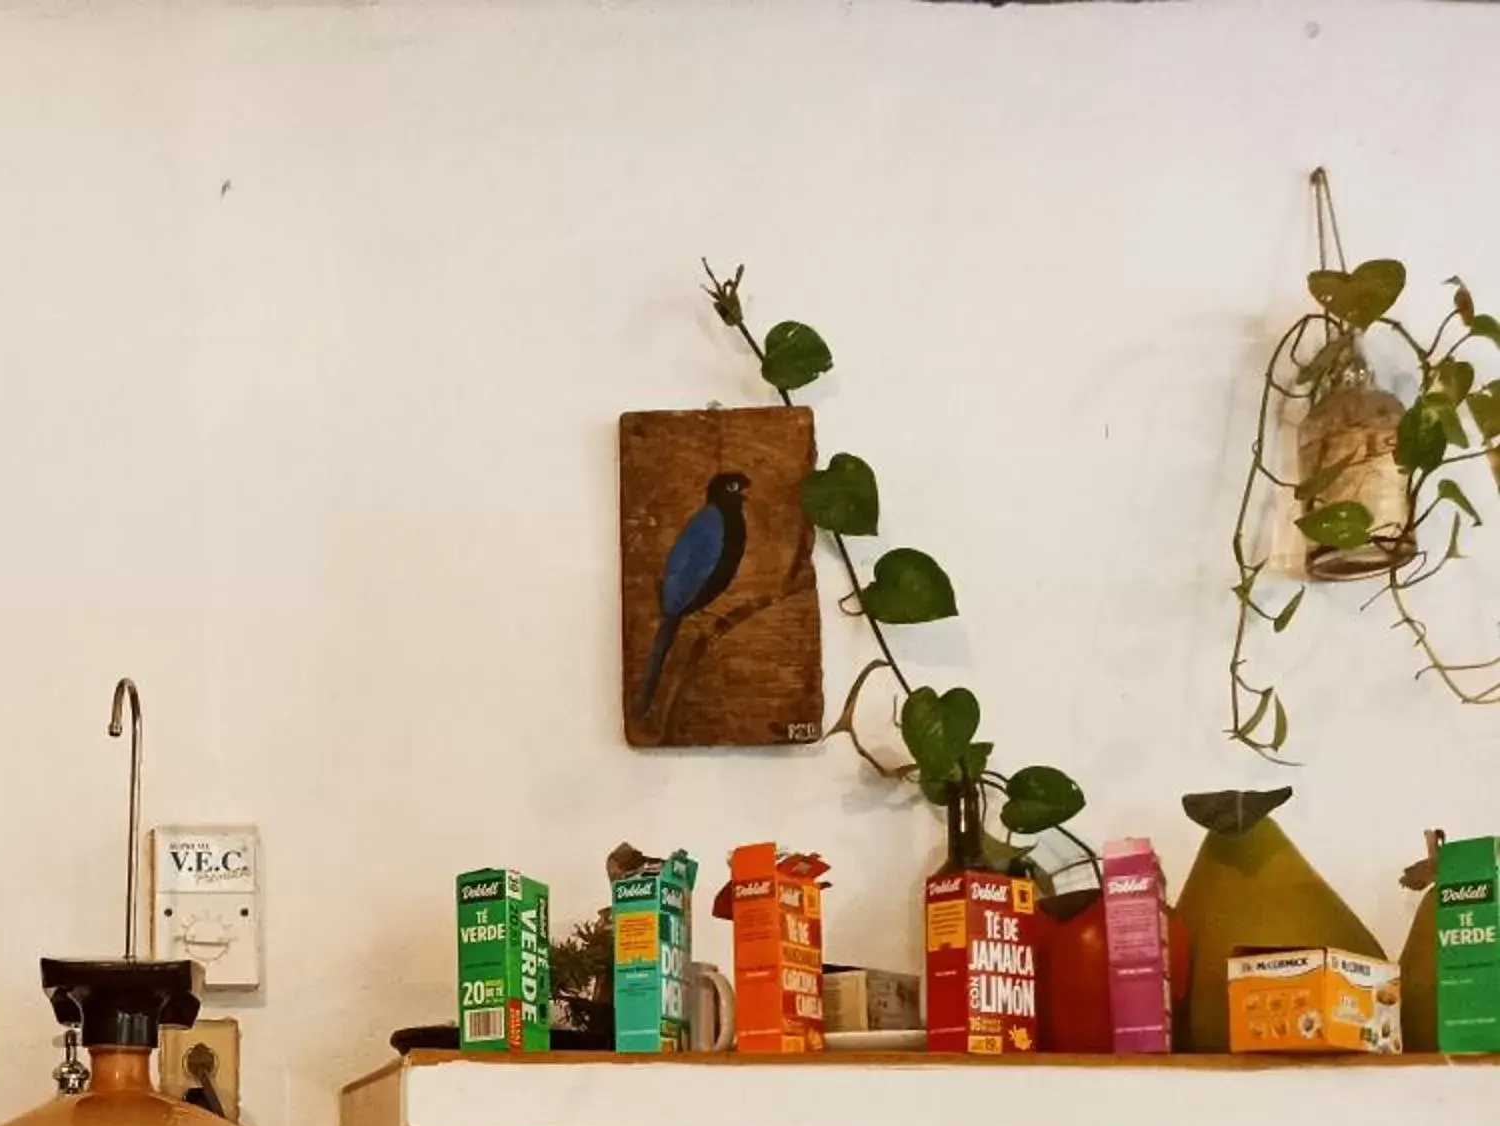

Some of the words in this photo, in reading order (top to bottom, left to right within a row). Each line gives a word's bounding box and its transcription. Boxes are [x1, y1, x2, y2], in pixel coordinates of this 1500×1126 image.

[461, 923, 506, 943] VERDE
[1003, 917, 1019, 942] DE
[1438, 926, 1496, 947] VERDE
[521, 909, 537, 1024] VERDE
[968, 940, 1035, 977] JAMAICA
[462, 981, 485, 1006] 20
[980, 974, 1035, 1018] LIMÓN
